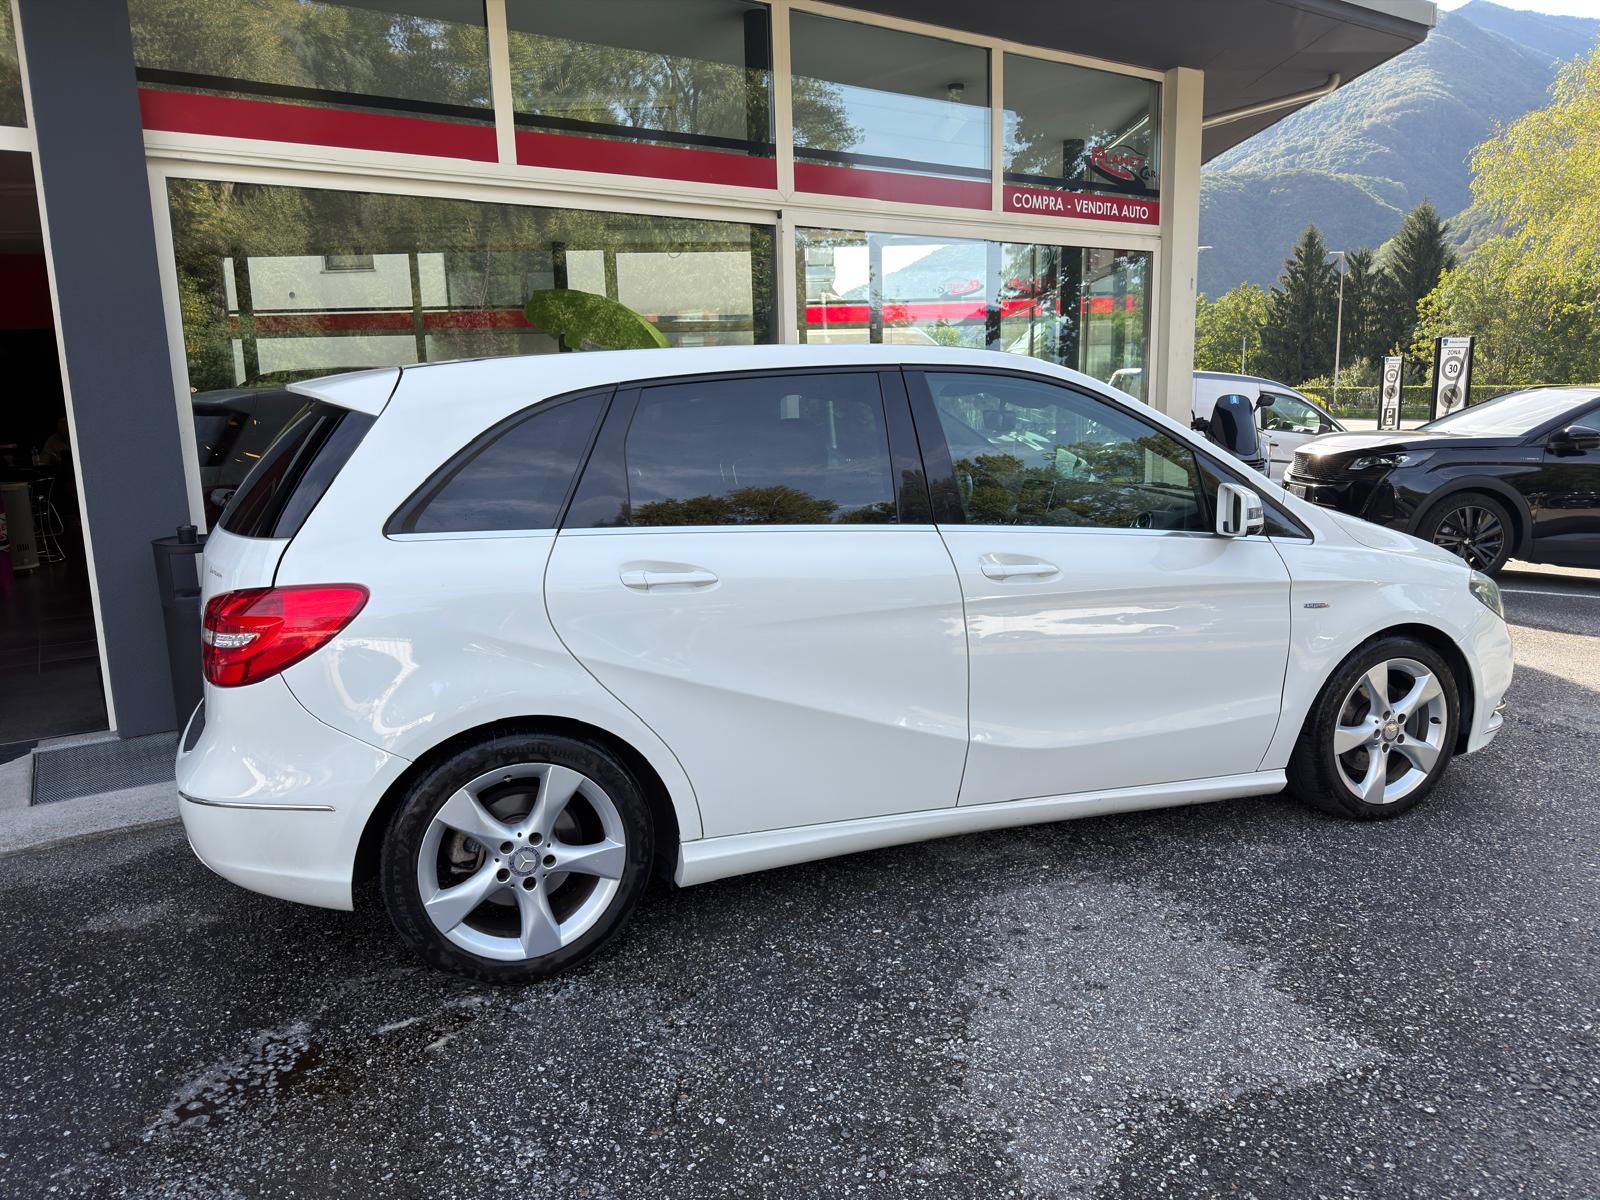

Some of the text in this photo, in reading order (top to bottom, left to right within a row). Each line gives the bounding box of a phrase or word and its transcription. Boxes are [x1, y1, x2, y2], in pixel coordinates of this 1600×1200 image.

[1012, 193, 1064, 211] COMPRA
[1074, 199, 1119, 217] VENDITA
[1121, 205, 1149, 220] AUTO
[1448, 364, 1458, 374] 30
